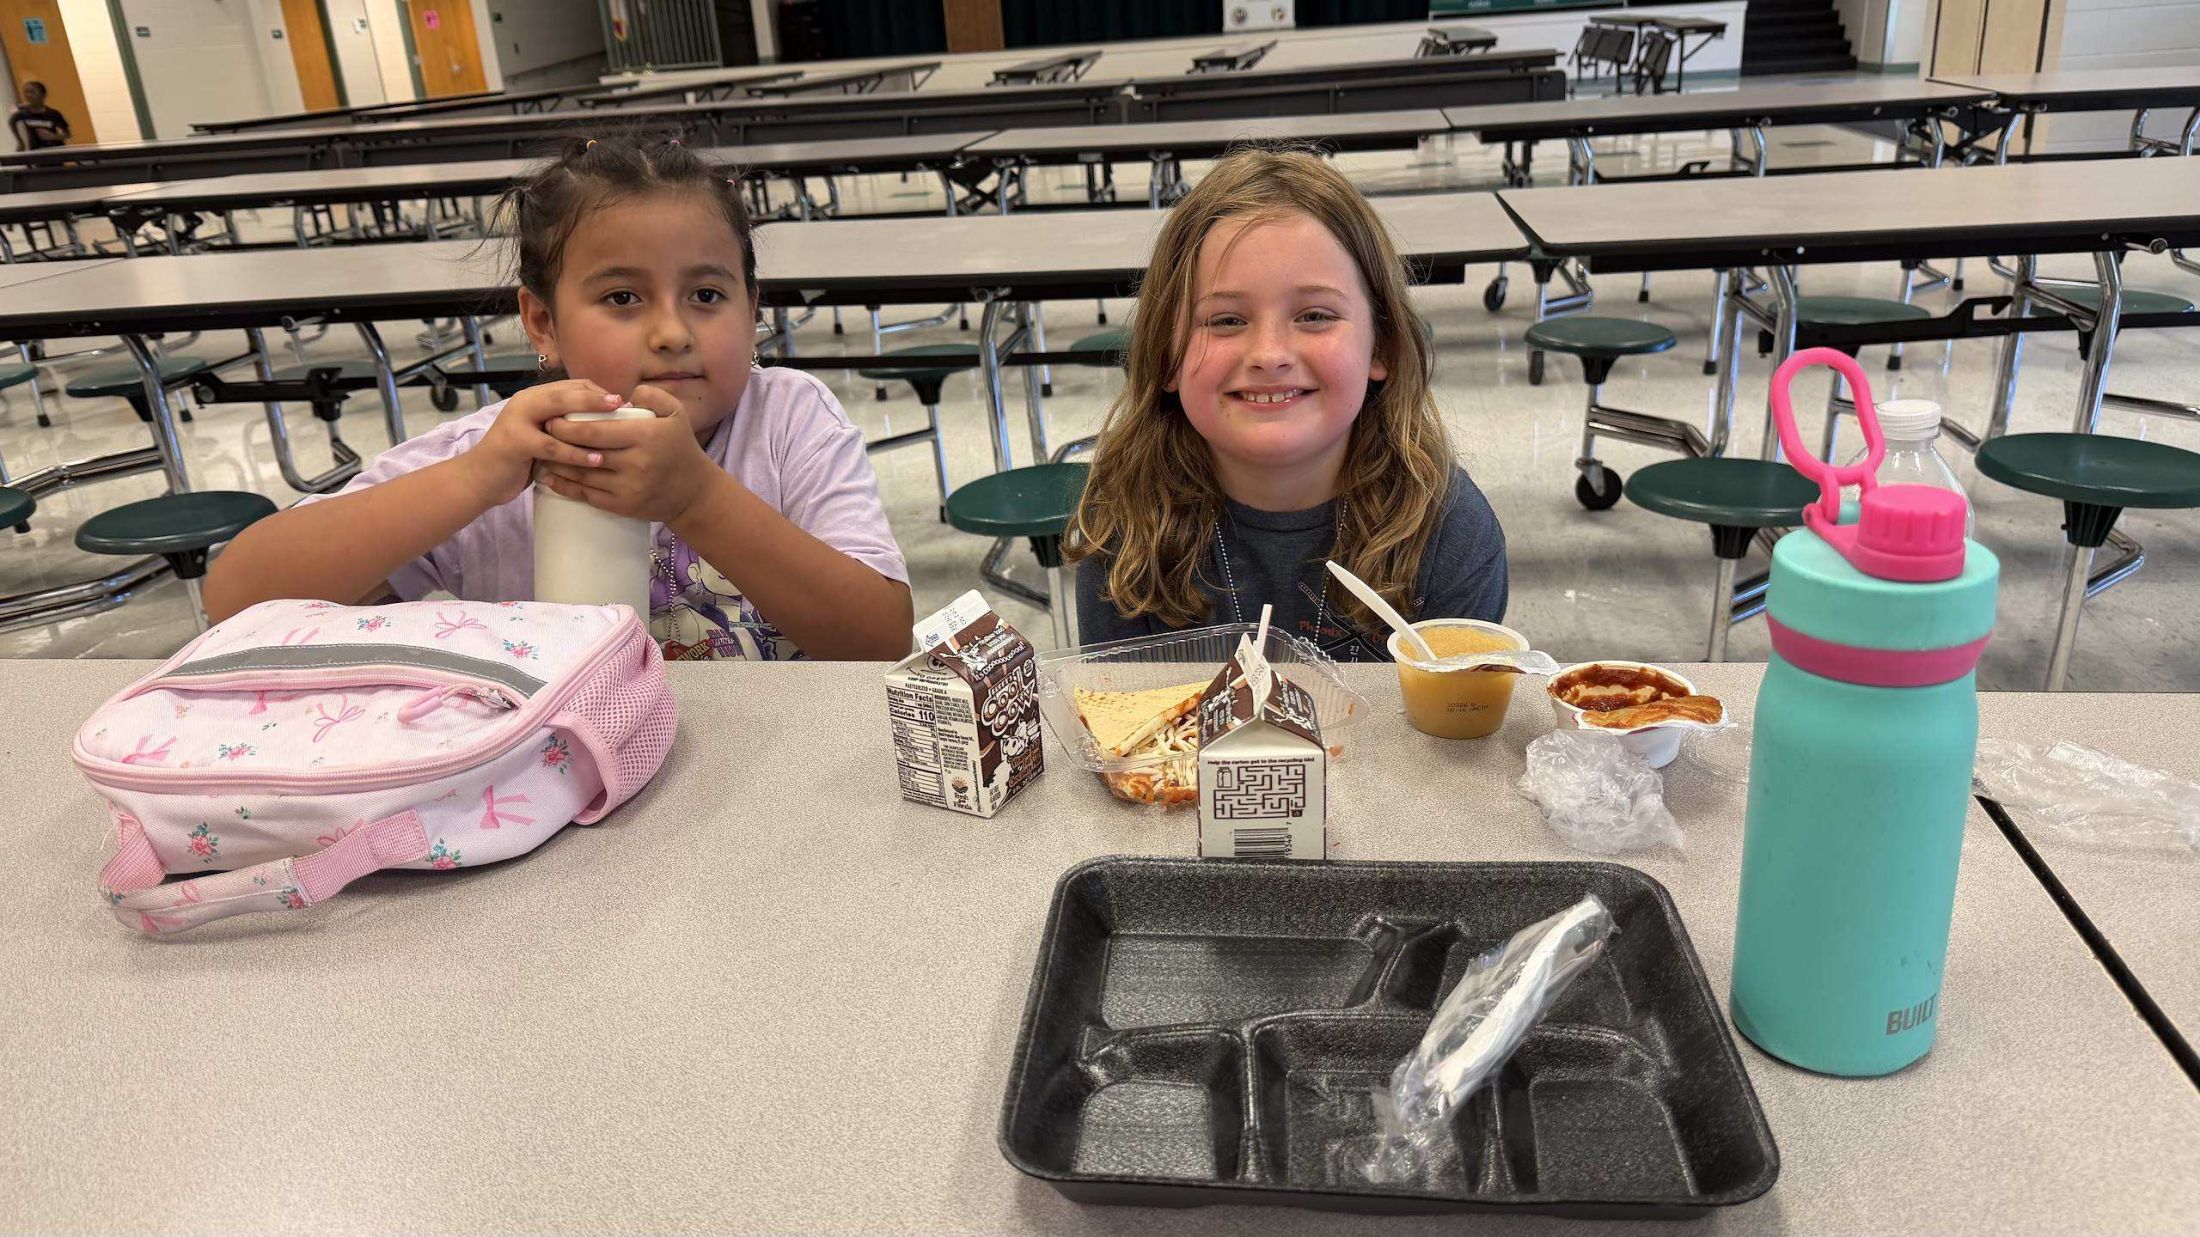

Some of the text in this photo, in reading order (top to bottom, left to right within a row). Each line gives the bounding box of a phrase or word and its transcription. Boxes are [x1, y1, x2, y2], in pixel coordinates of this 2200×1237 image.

[887, 688, 914, 699] Nutrition
[914, 693, 933, 703] Facts
[889, 707, 915, 718] Calories
[919, 710, 935, 721] 110
[1886, 992, 1937, 1036] BUILT
